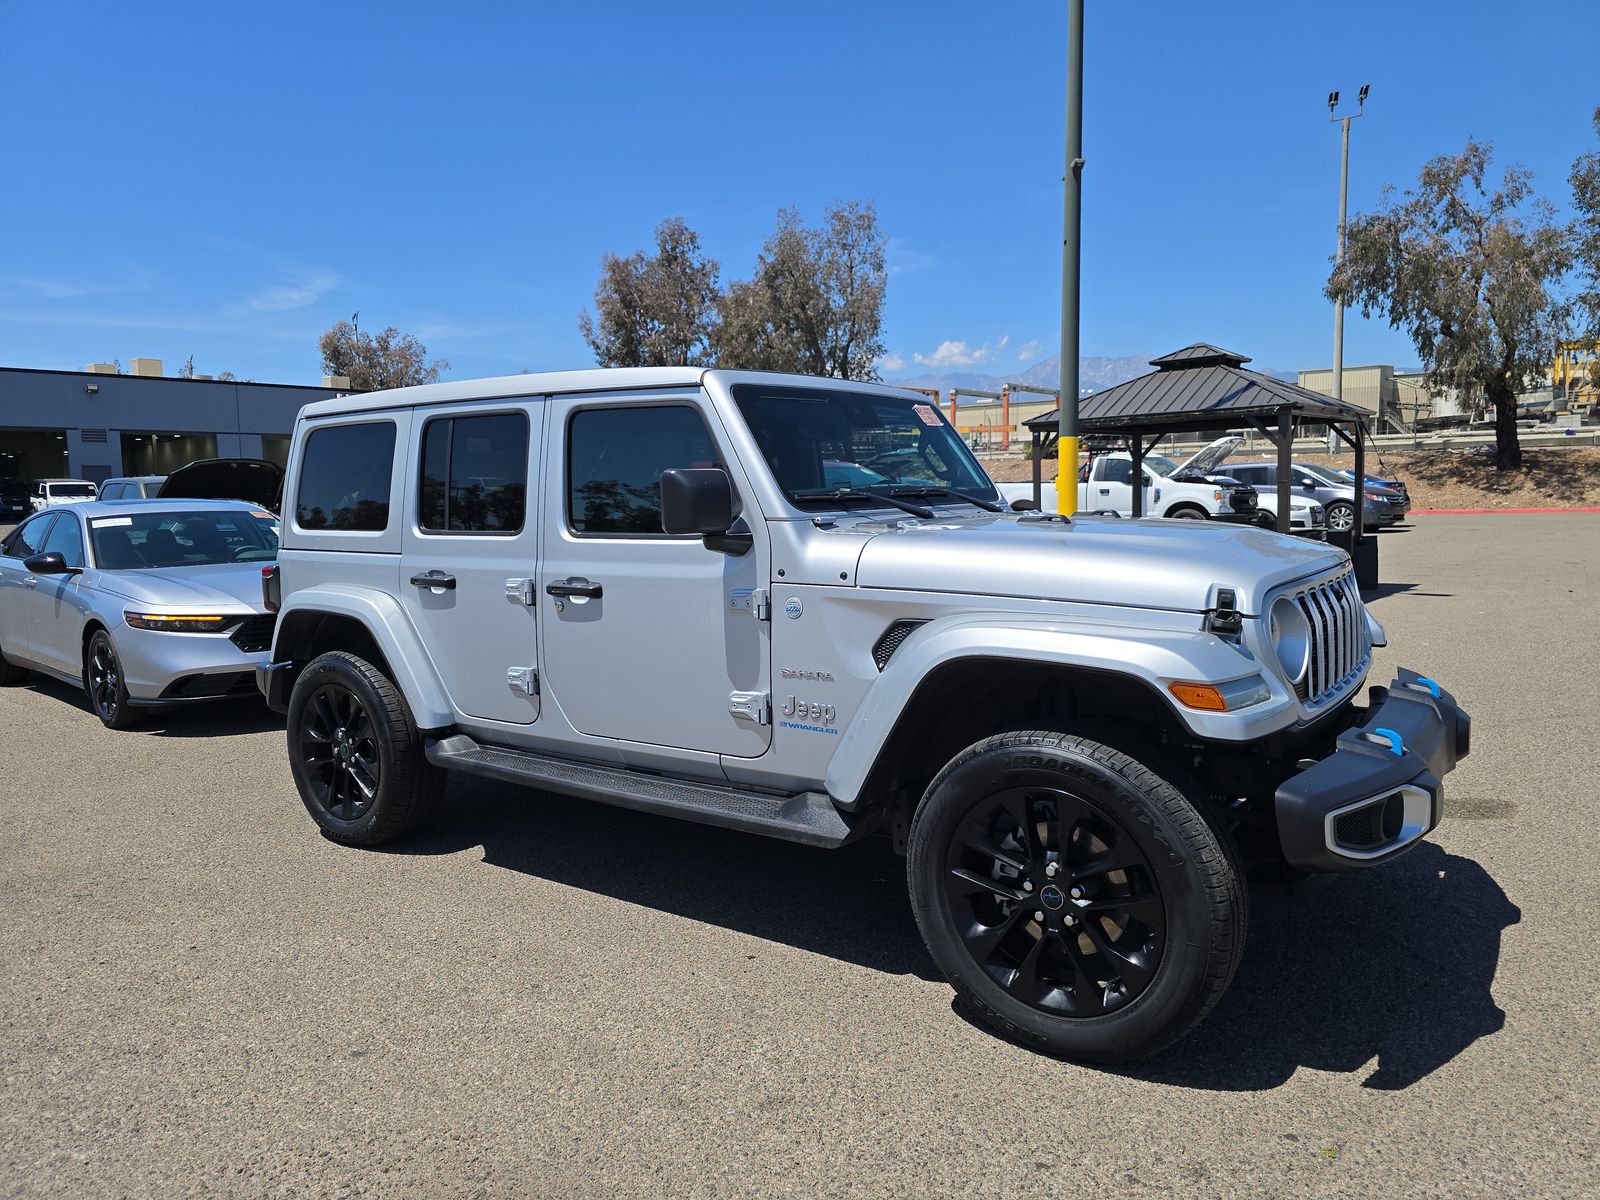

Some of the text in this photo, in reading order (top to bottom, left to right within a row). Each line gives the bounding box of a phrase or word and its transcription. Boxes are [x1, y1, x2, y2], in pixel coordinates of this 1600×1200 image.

[781, 668, 835, 682] SAHARA
[781, 695, 836, 726] Jeep
[788, 722, 838, 734] WRANGLER
